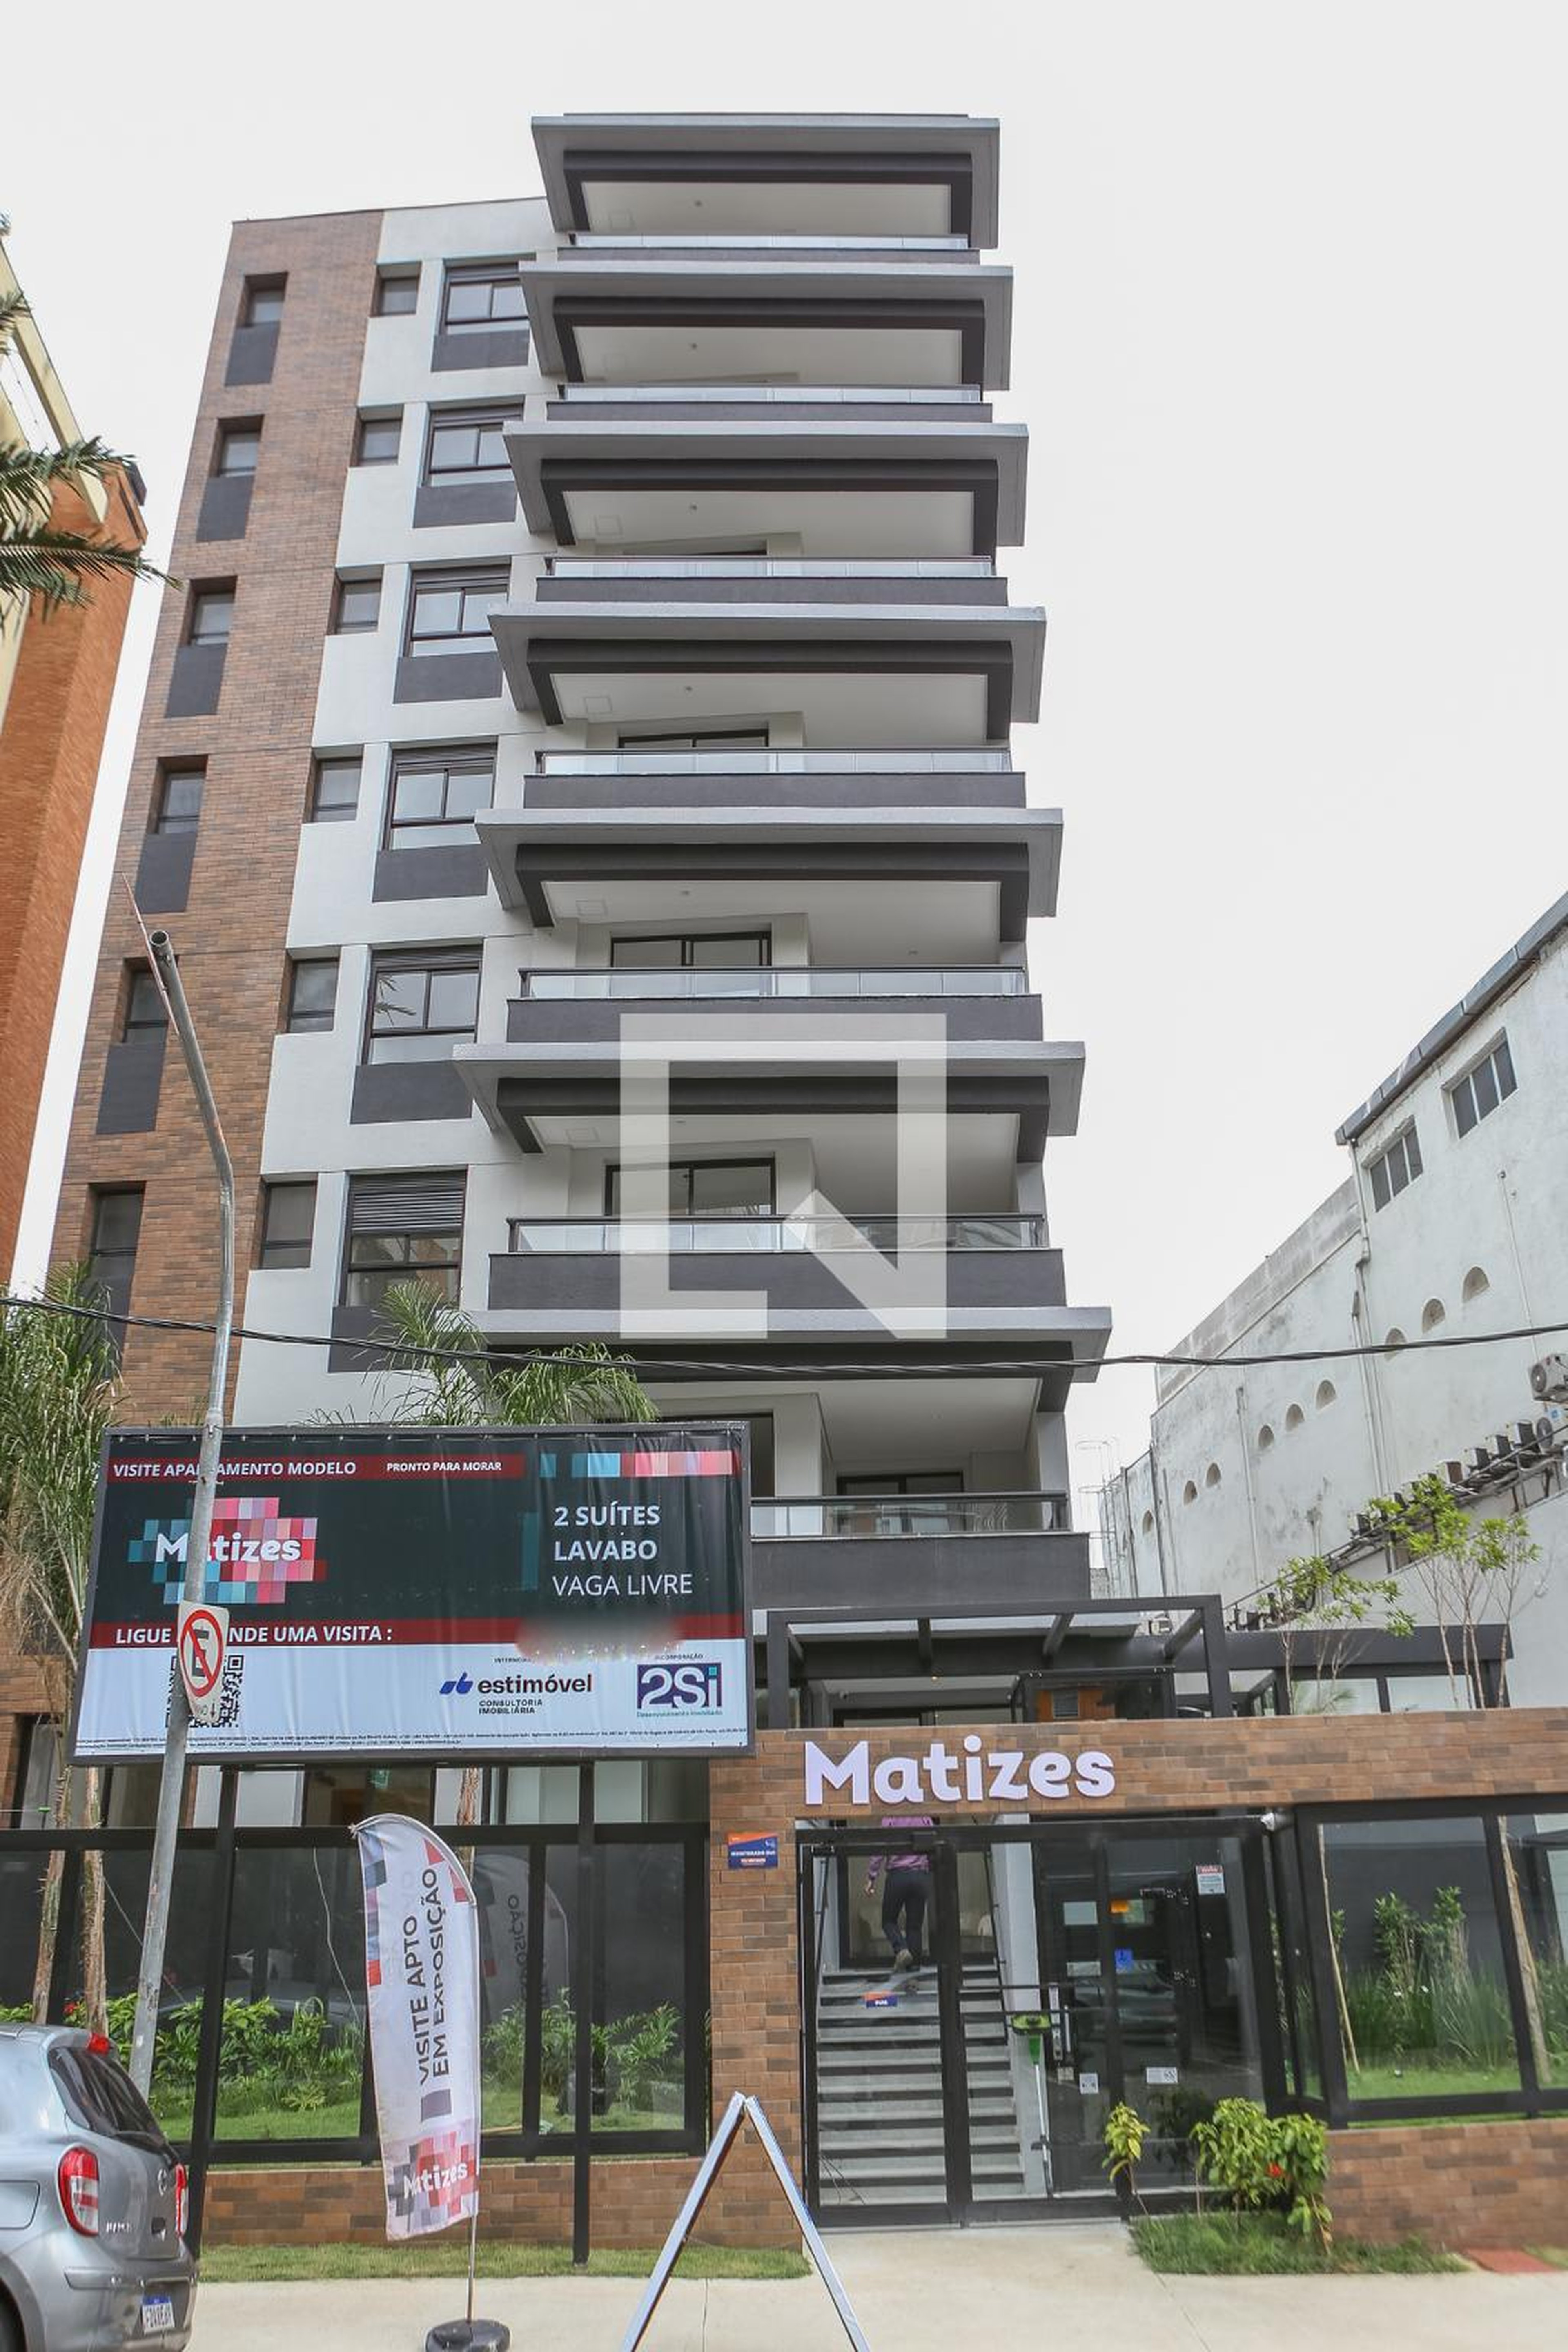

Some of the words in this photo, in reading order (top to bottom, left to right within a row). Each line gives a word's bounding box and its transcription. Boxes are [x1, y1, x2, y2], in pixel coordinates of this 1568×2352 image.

[114, 1464, 160, 1476] VISITE
[164, 1462, 283, 1476] APAAMENTO
[288, 1461, 356, 1475] MODELO
[387, 1463, 431, 1471] PRONTO
[432, 1462, 461, 1471] PARA
[463, 1462, 502, 1471] MORAR
[554, 1506, 568, 1526] 2
[575, 1501, 661, 1526] SUÍTES
[155, 1532, 301, 1562] Mtizes
[554, 1540, 657, 1561] LAVABO
[552, 1575, 620, 1596] VAGA
[628, 1574, 693, 1595] LIVRE
[116, 1628, 171, 1643] LIGUE
[273, 1627, 318, 1642] UMA
[323, 1625, 382, 1641] VISITA
[477, 1673, 592, 1694] estimóvel
[479, 1706, 535, 1715] IMOBILIÁRIA
[804, 1735, 1116, 1805] Matizes
[403, 1915, 426, 1987] APTO
[421, 1869, 447, 2026] EXPOSIÇÃO
[410, 1996, 430, 2085] VISITE
[433, 2033, 450, 2078] EM
